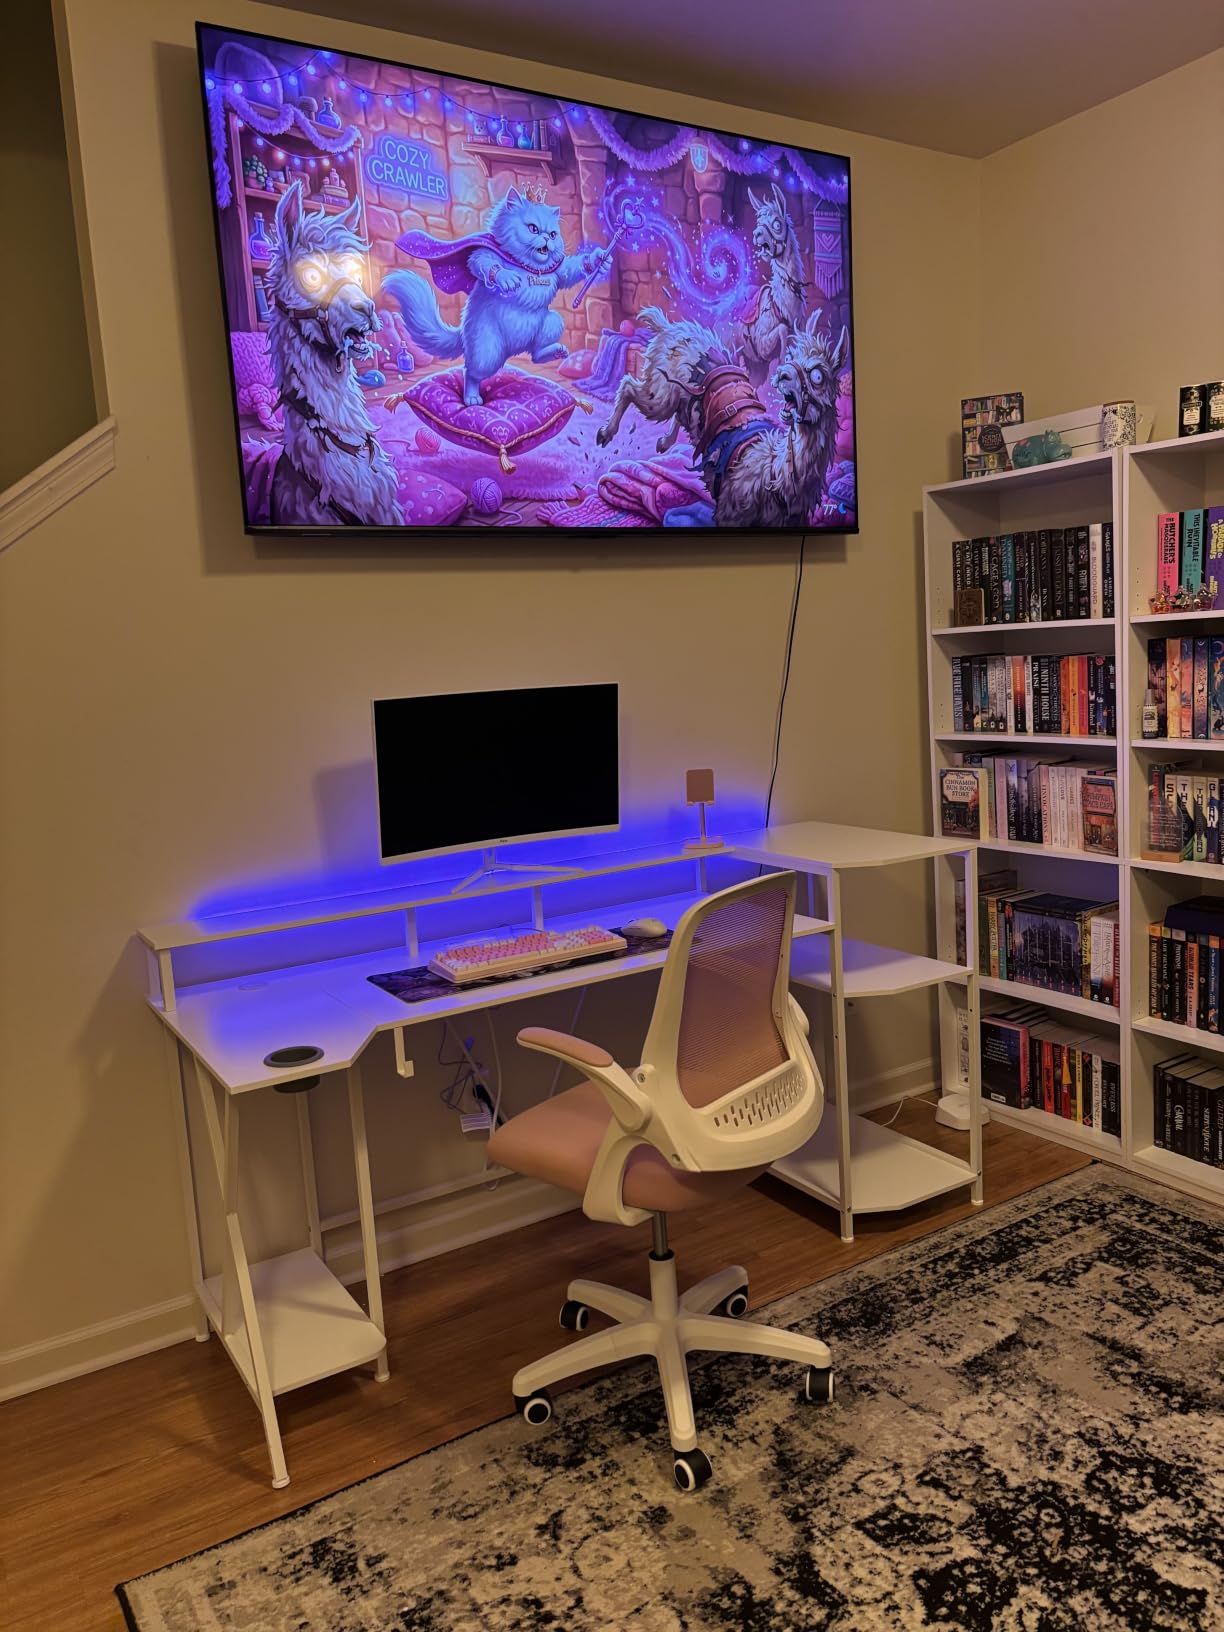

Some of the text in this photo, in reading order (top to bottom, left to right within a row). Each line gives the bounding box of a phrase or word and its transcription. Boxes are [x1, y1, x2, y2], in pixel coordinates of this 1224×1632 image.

[384, 140, 429, 170] COZY
[371, 159, 446, 197] CRAWLER
[1193, 513, 1201, 527] THIS
[1168, 523, 1176, 564] BUTCHER'S
[1192, 527, 1201, 562] INEVITABLE
[991, 557, 999, 579] CAGE
[992, 587, 1000, 608] GOD
[1040, 668, 1050, 721] NINTH HOUSE
